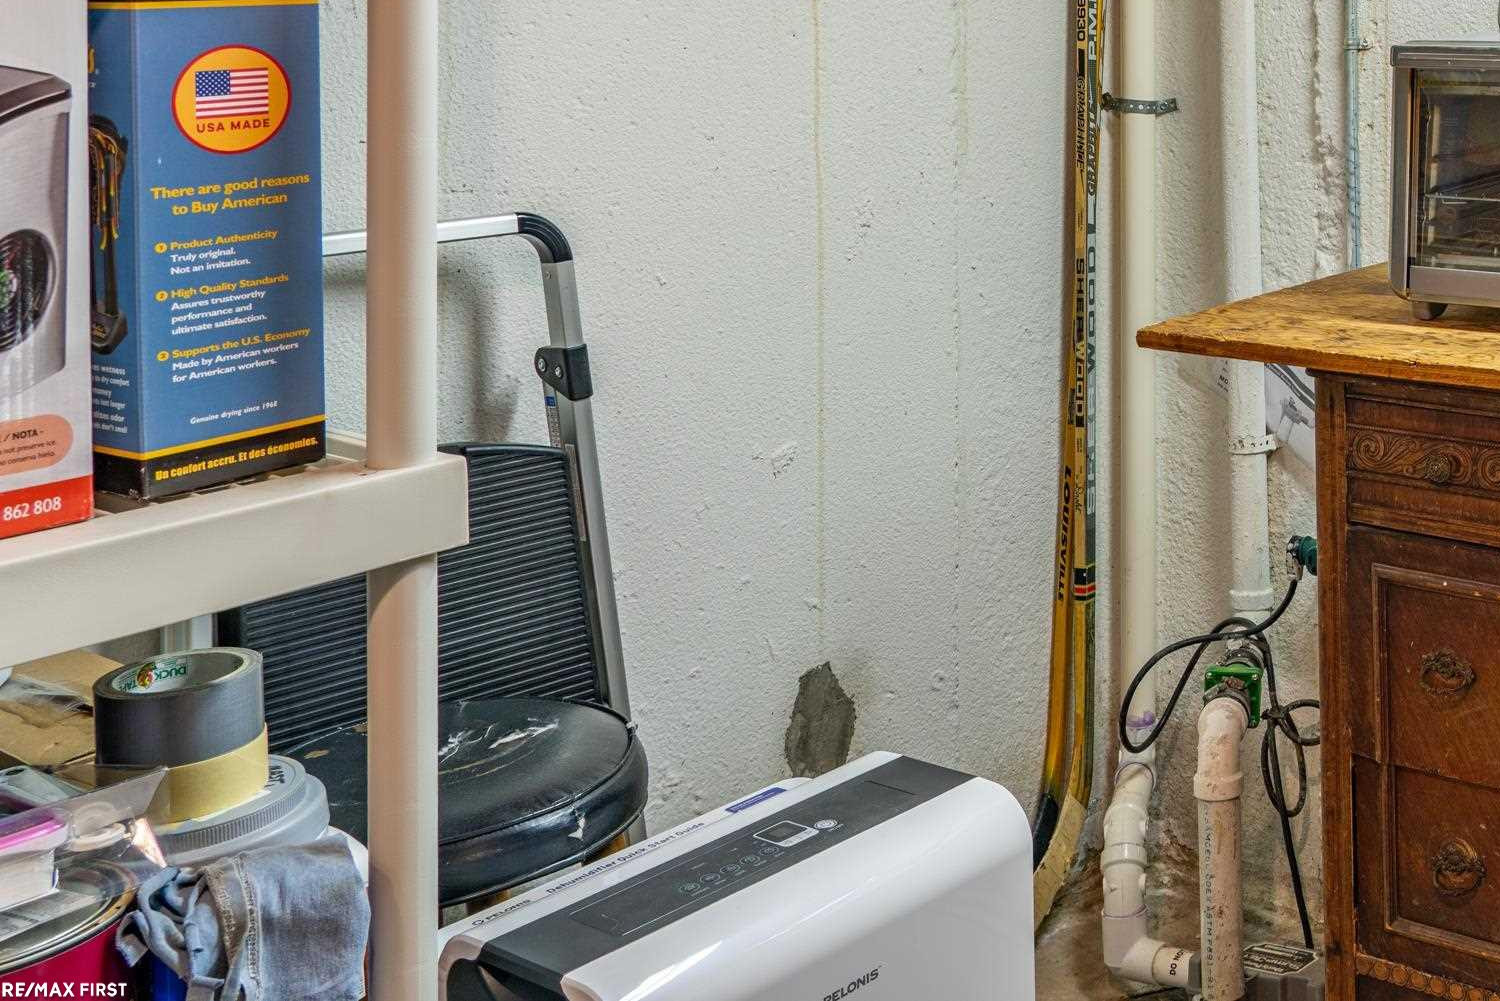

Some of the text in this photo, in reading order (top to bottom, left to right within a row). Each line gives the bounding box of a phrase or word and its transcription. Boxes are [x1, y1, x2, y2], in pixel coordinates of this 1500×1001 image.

[196, 118, 271, 133] USA MADE
[151, 173, 310, 200] There are good reasons
[172, 193, 288, 215] to Buy American
[170, 239, 213, 251] Product
[215, 229, 279, 245] Authenticity
[170, 247, 236, 263] Truly original.
[170, 258, 251, 275] Not an imitation.
[171, 287, 197, 299] High
[200, 282, 237, 295] Quality
[240, 273, 289, 288] Standards
[171, 290, 266, 311] Assures trustworthy
[171, 303, 252, 325] performance and
[172, 313, 267, 335] ultimate satisfaction.
[172, 345, 221, 360] Supports
[223, 340, 239, 349] the
[241, 335, 261, 346] U.S.
[264, 327, 311, 342] Economy
[172, 342, 299, 371] Made by American workers
[173, 358, 278, 383] for American workers.
[190, 413, 219, 425] Genuine
[221, 409, 242, 420] drying
[244, 405, 260, 415] since
[12, 429, 38, 441] NOTA
[155, 437, 318, 481] Un confort accru. Et des économies.
[3, 496, 61, 522] 862 808
[1057, 464, 1072, 602] LOUISVILLE
[155, 666, 187, 681] DUCK
[546, 860, 617, 895] Dehumidifier
[617, 845, 648, 863] Quick
[647, 833, 675, 851] Start
[675, 821, 706, 838] Guide
[823, 968, 879, 1001] PELONIS
